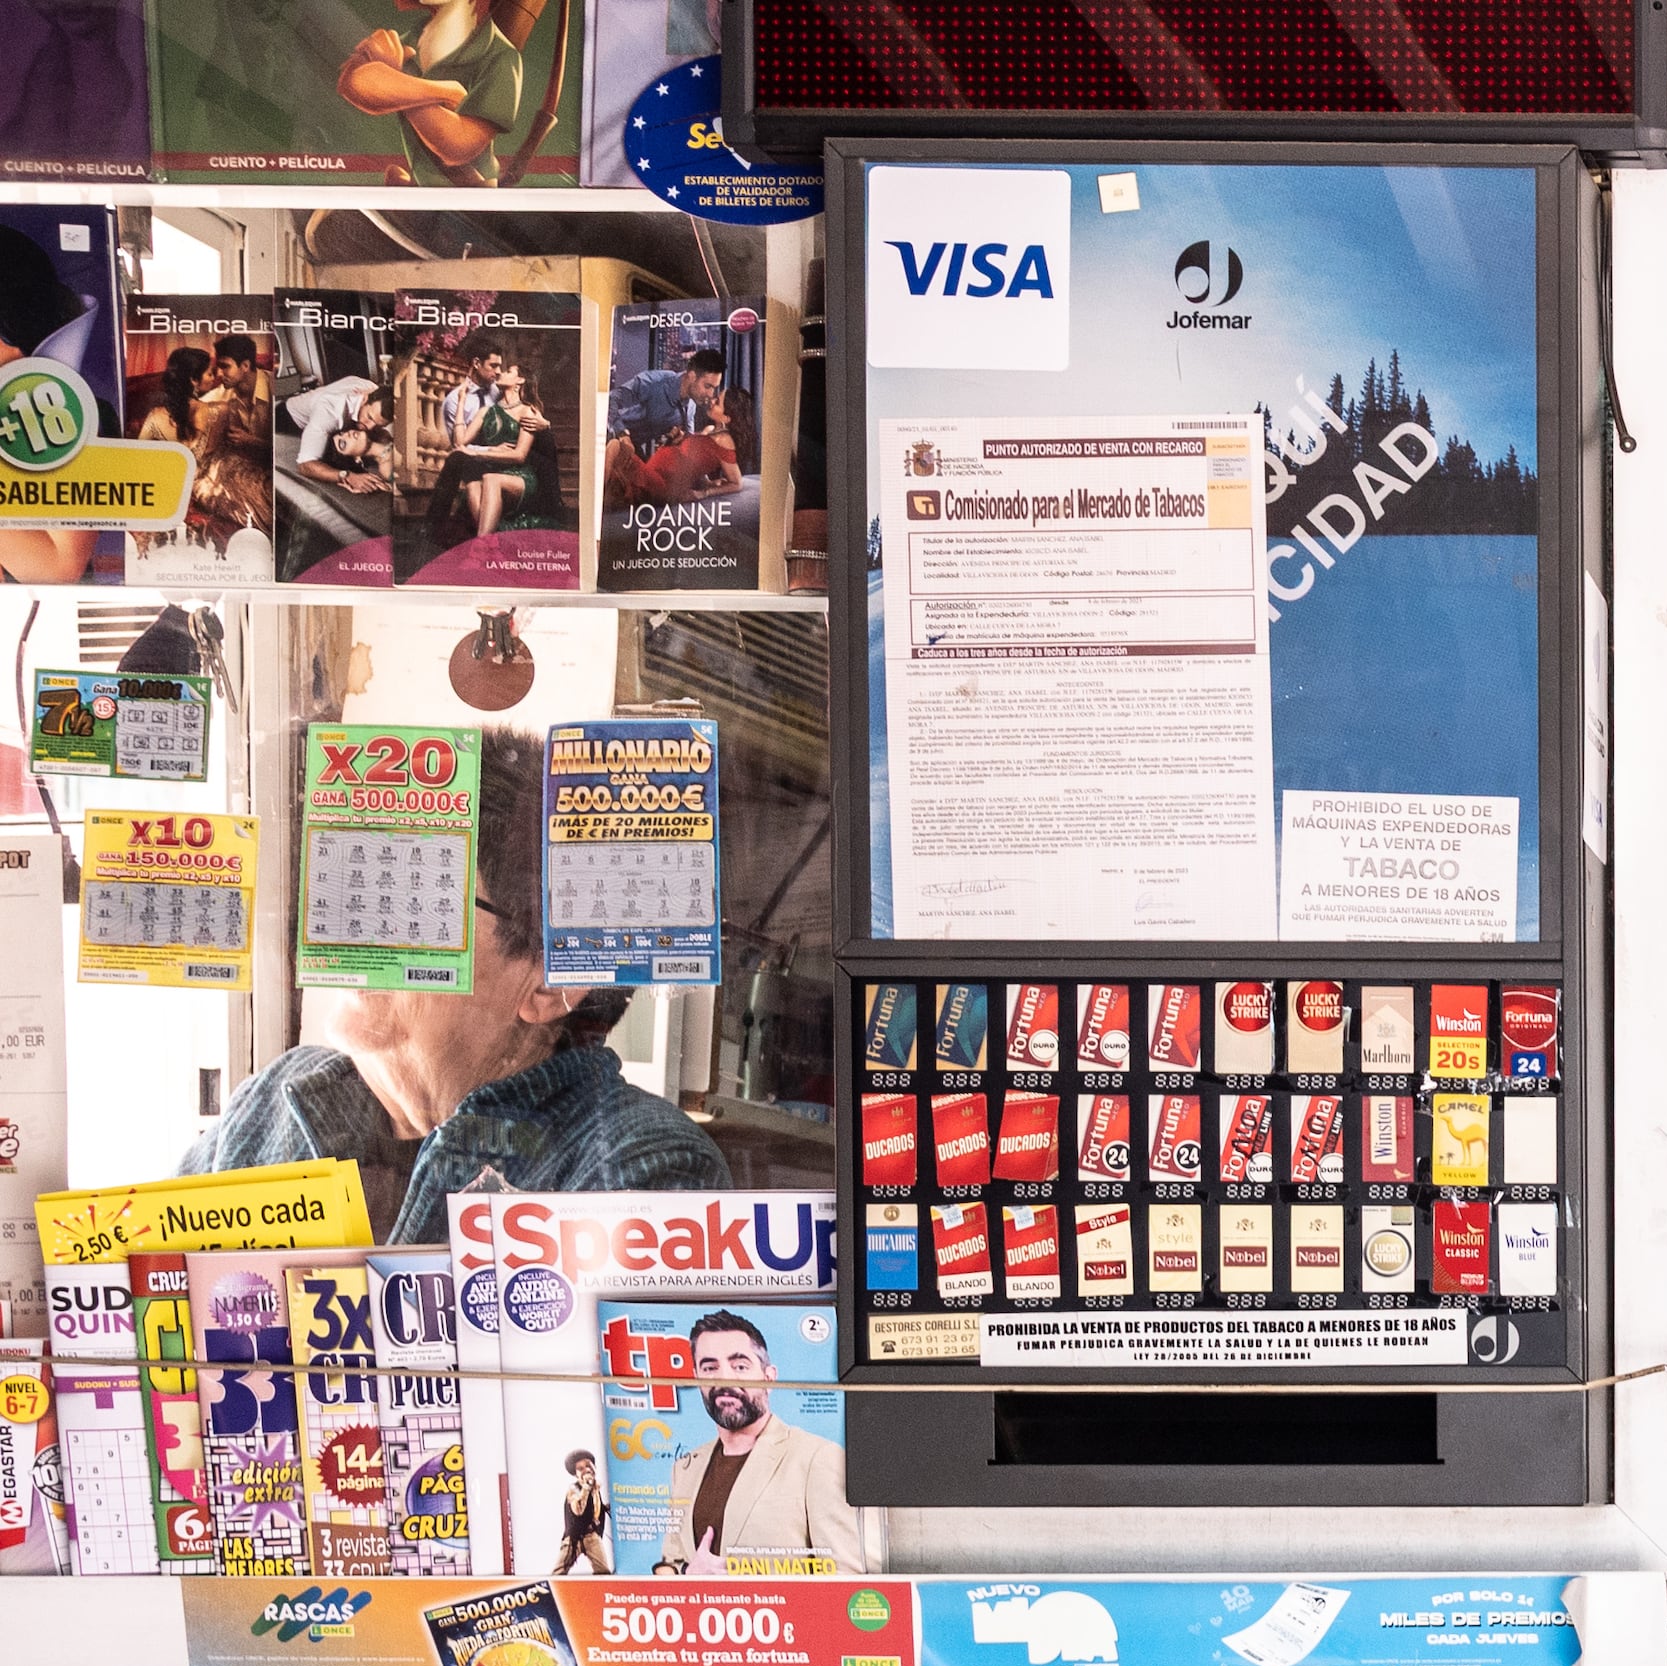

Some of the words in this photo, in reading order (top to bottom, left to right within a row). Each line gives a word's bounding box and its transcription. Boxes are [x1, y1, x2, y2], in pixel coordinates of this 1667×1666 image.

[210, 157, 266, 168] CUENTO
[279, 155, 346, 168] PELÍCULA
[885, 241, 1053, 298] VISA
[417, 306, 520, 327] Bianca
[1167, 311, 1252, 329] Jofemar
[623, 500, 734, 530] JOANNE
[945, 489, 1028, 521] Comisionado
[1032, 496, 1059, 526] para
[1063, 488, 1074, 519] el
[1078, 488, 1131, 518] Mercado
[1135, 488, 1150, 518] de
[1152, 487, 1204, 518] Tabacos
[637, 523, 712, 552] ROCK
[552, 741, 711, 775] MILLONARIO
[1310, 800, 1402, 815] PROHIBIDO
[1408, 803, 1427, 815] EL
[1433, 804, 1465, 816] USO
[1472, 806, 1492, 817] DE
[1293, 814, 1376, 830] MÁQUINAS
[1383, 820, 1511, 835] EXPENDEDORAS
[1341, 836, 1350, 848] Y
[1360, 837, 1378, 848] LA
[1384, 837, 1435, 850] VENTA
[1441, 839, 1461, 852] DE
[1343, 856, 1459, 881] TABACO
[1301, 884, 1312, 895] A
[1318, 884, 1400, 899] MENORES
[1407, 887, 1427, 899] DE
[1434, 888, 1448, 900] 18
[1454, 886, 1500, 902] AÑOS
[1362, 1047, 1411, 1067] Marlboro
[1437, 1051, 1479, 1069] 20s
[1438, 1103, 1485, 1116] CAMEL
[866, 1131, 914, 1160] DUCADOS
[159, 1205, 251, 1238] ¡Nuevo
[261, 1194, 325, 1238] cada
[1225, 1250, 1266, 1264] Nobel
[988, 1322, 1060, 1336] PROHIBIDA
[1064, 1322, 1078, 1334] LA
[1081, 1322, 1121, 1333] VENTA
[1125, 1322, 1140, 1333] DE
[1144, 1321, 1223, 1334] PRODUCTOS
[1227, 1321, 1249, 1333] DEL
[1253, 1321, 1303, 1333] TABACO
[1308, 1321, 1316, 1332] A
[1320, 1320, 1381, 1332] MENORES
[1385, 1320, 1400, 1331] DE
[1404, 1319, 1418, 1331] 18
[1422, 1317, 1456, 1330] AÑOS
[605, 1593, 648, 1604] Puedes
[651, 1596, 686, 1606] ganar
[689, 1593, 700, 1604] al
[704, 1593, 751, 1604] instante
[754, 1594, 786, 1604] hasta
